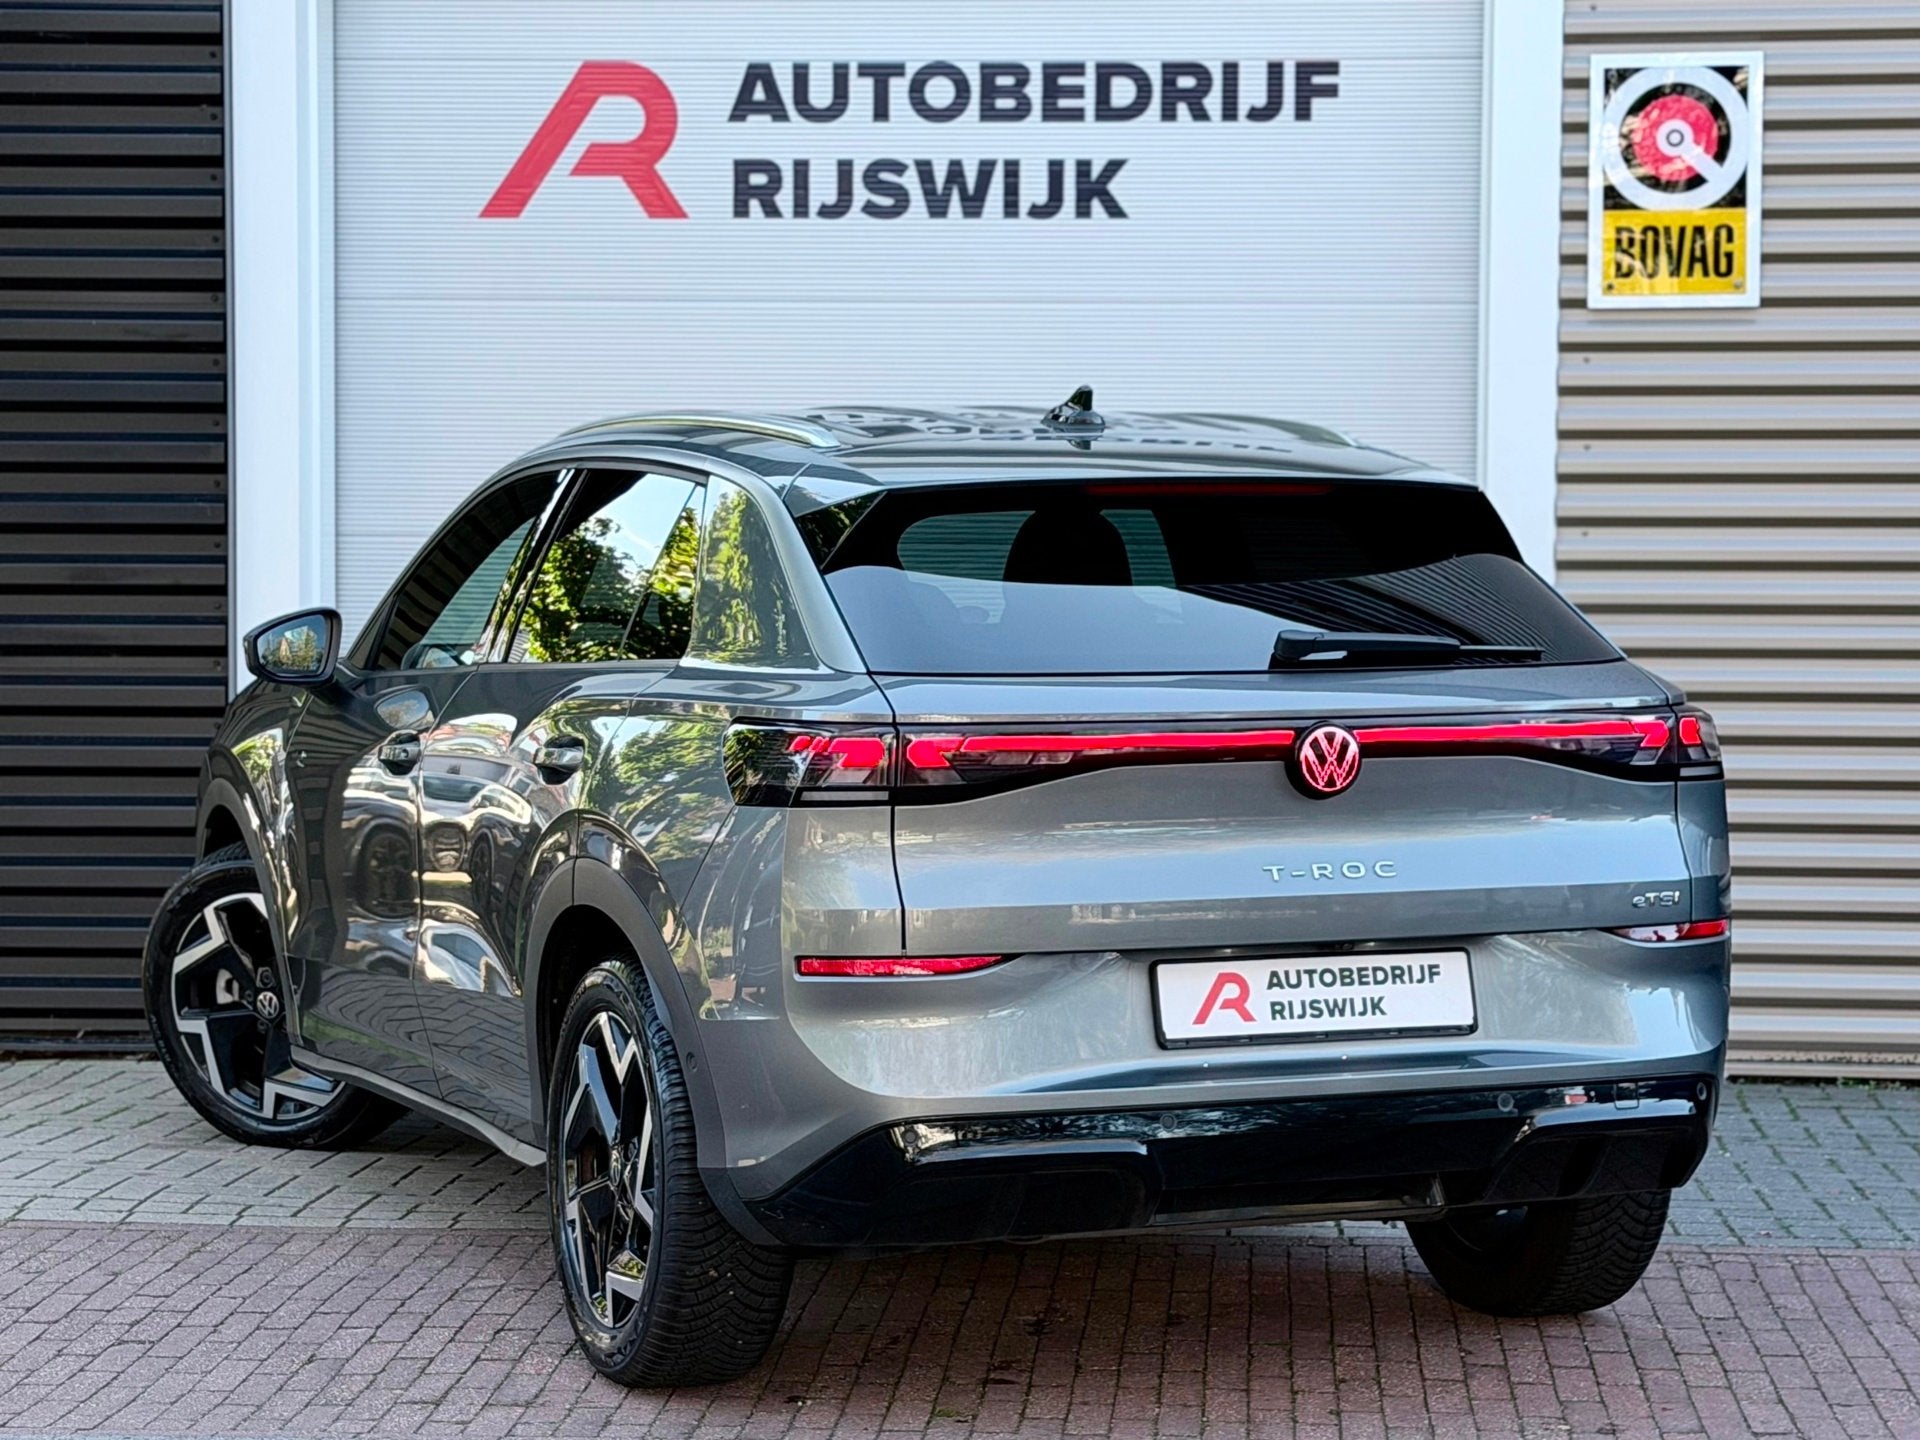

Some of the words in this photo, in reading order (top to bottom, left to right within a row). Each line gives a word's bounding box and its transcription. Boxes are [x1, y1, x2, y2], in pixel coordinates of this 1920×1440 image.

[728, 61, 1340, 122] AUTOBEDRIJF
[732, 159, 1127, 219] RIJSWIJK
[1615, 224, 1734, 278] BOVAG
[1263, 862, 1398, 882] T-ROC
[1632, 891, 1681, 908] eTSI
[1266, 964, 1441, 990] AUTOBEDRIJF
[1269, 997, 1387, 1021] RIJSWIJK
